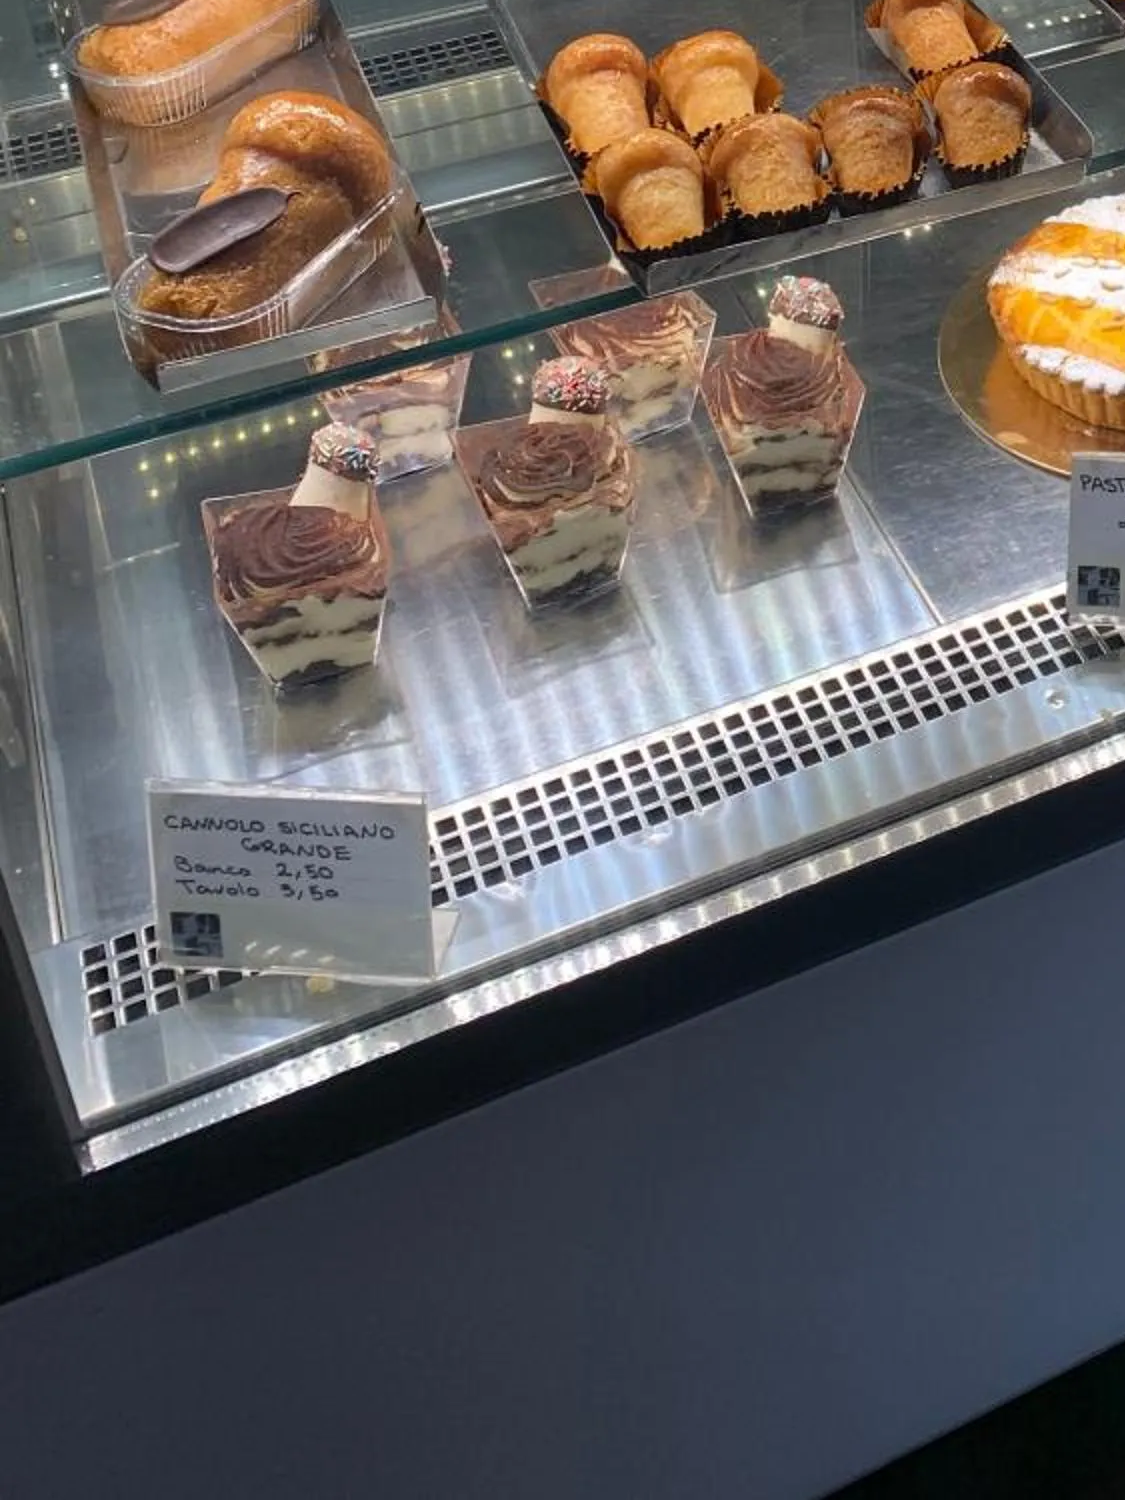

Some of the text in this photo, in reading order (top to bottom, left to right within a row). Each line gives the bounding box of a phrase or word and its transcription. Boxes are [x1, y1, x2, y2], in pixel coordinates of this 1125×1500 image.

[164, 815, 395, 840] CANNOLO SICILIANO
[240, 837, 352, 861] GRANDE
[174, 855, 334, 880] Banco 2,50
[175, 879, 260, 897] Tavolo
